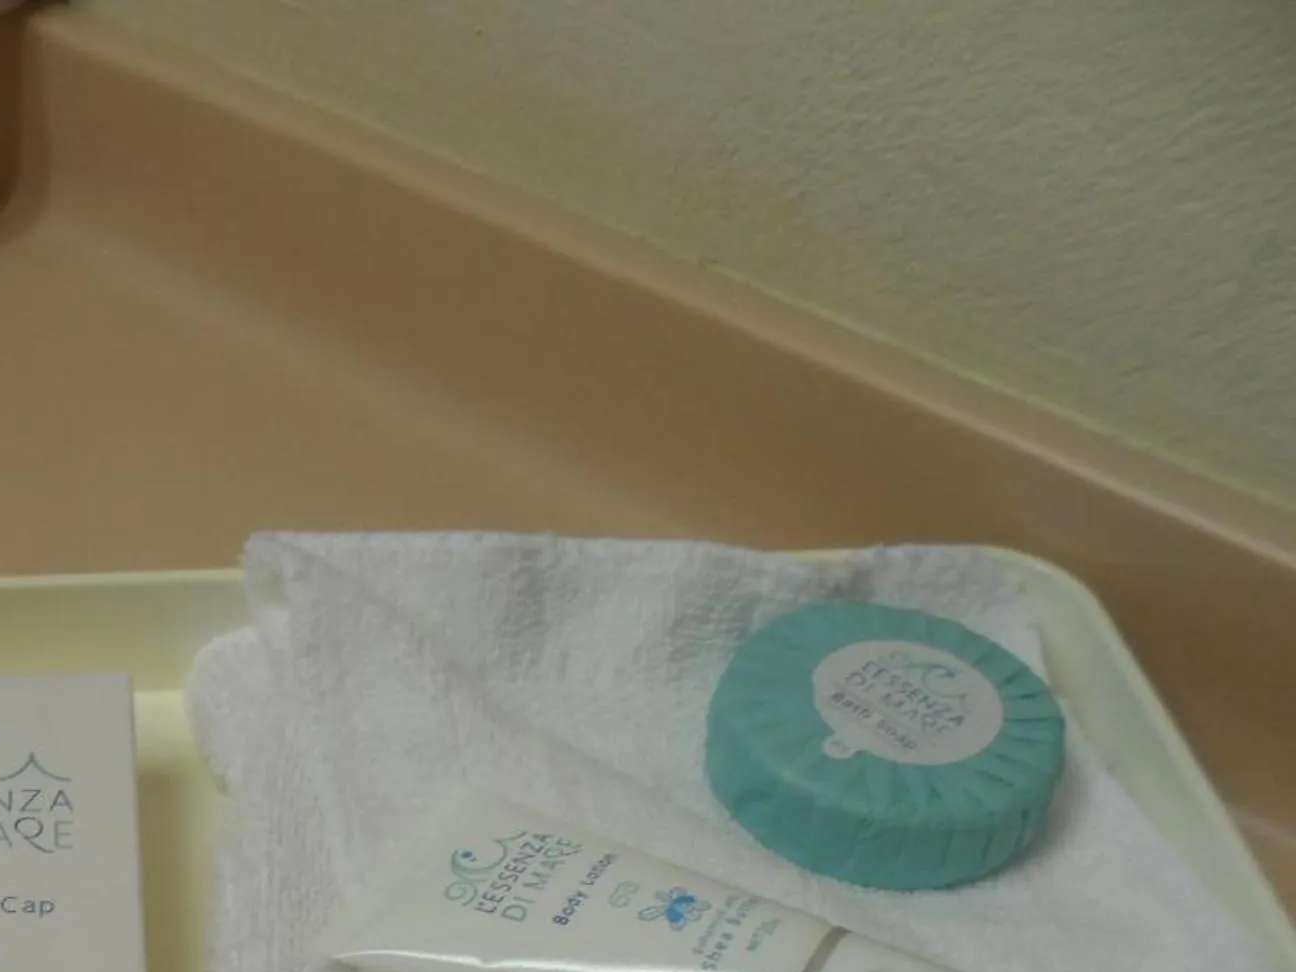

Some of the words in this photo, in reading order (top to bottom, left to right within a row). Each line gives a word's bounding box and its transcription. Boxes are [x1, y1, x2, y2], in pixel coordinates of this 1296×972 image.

[844, 670, 875, 694] DI
[0, 895, 56, 919] Cap
[500, 893, 536, 924] DI
[550, 888, 588, 928] Body
